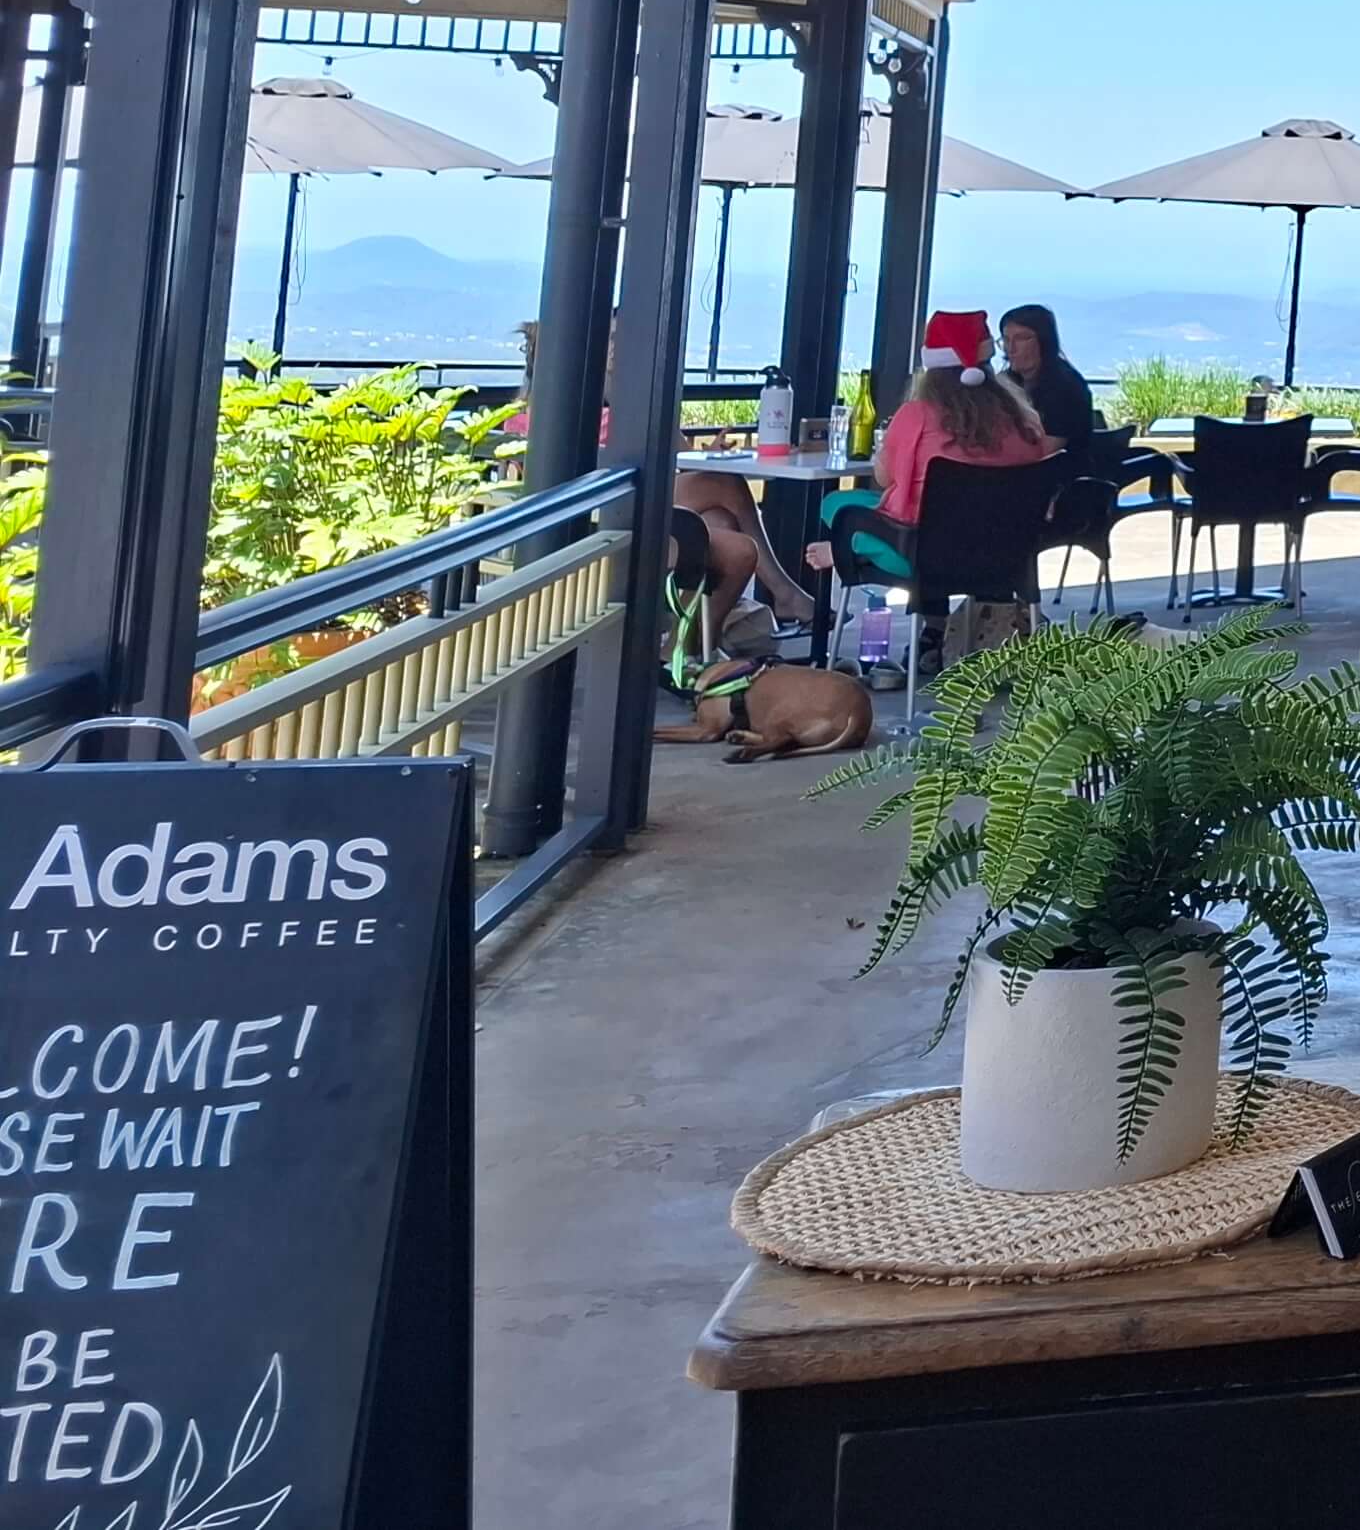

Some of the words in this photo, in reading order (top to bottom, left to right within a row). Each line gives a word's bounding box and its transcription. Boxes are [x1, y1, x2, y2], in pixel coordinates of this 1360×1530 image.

[9, 821, 389, 910] Adams
[9, 928, 109, 956] LTY
[152, 918, 378, 952] COFFEE
[0, 1110, 85, 1176] SE
[98, 1102, 261, 1170] WAIT
[16, 1330, 115, 1391] BE
[0, 1400, 163, 1485] TED
